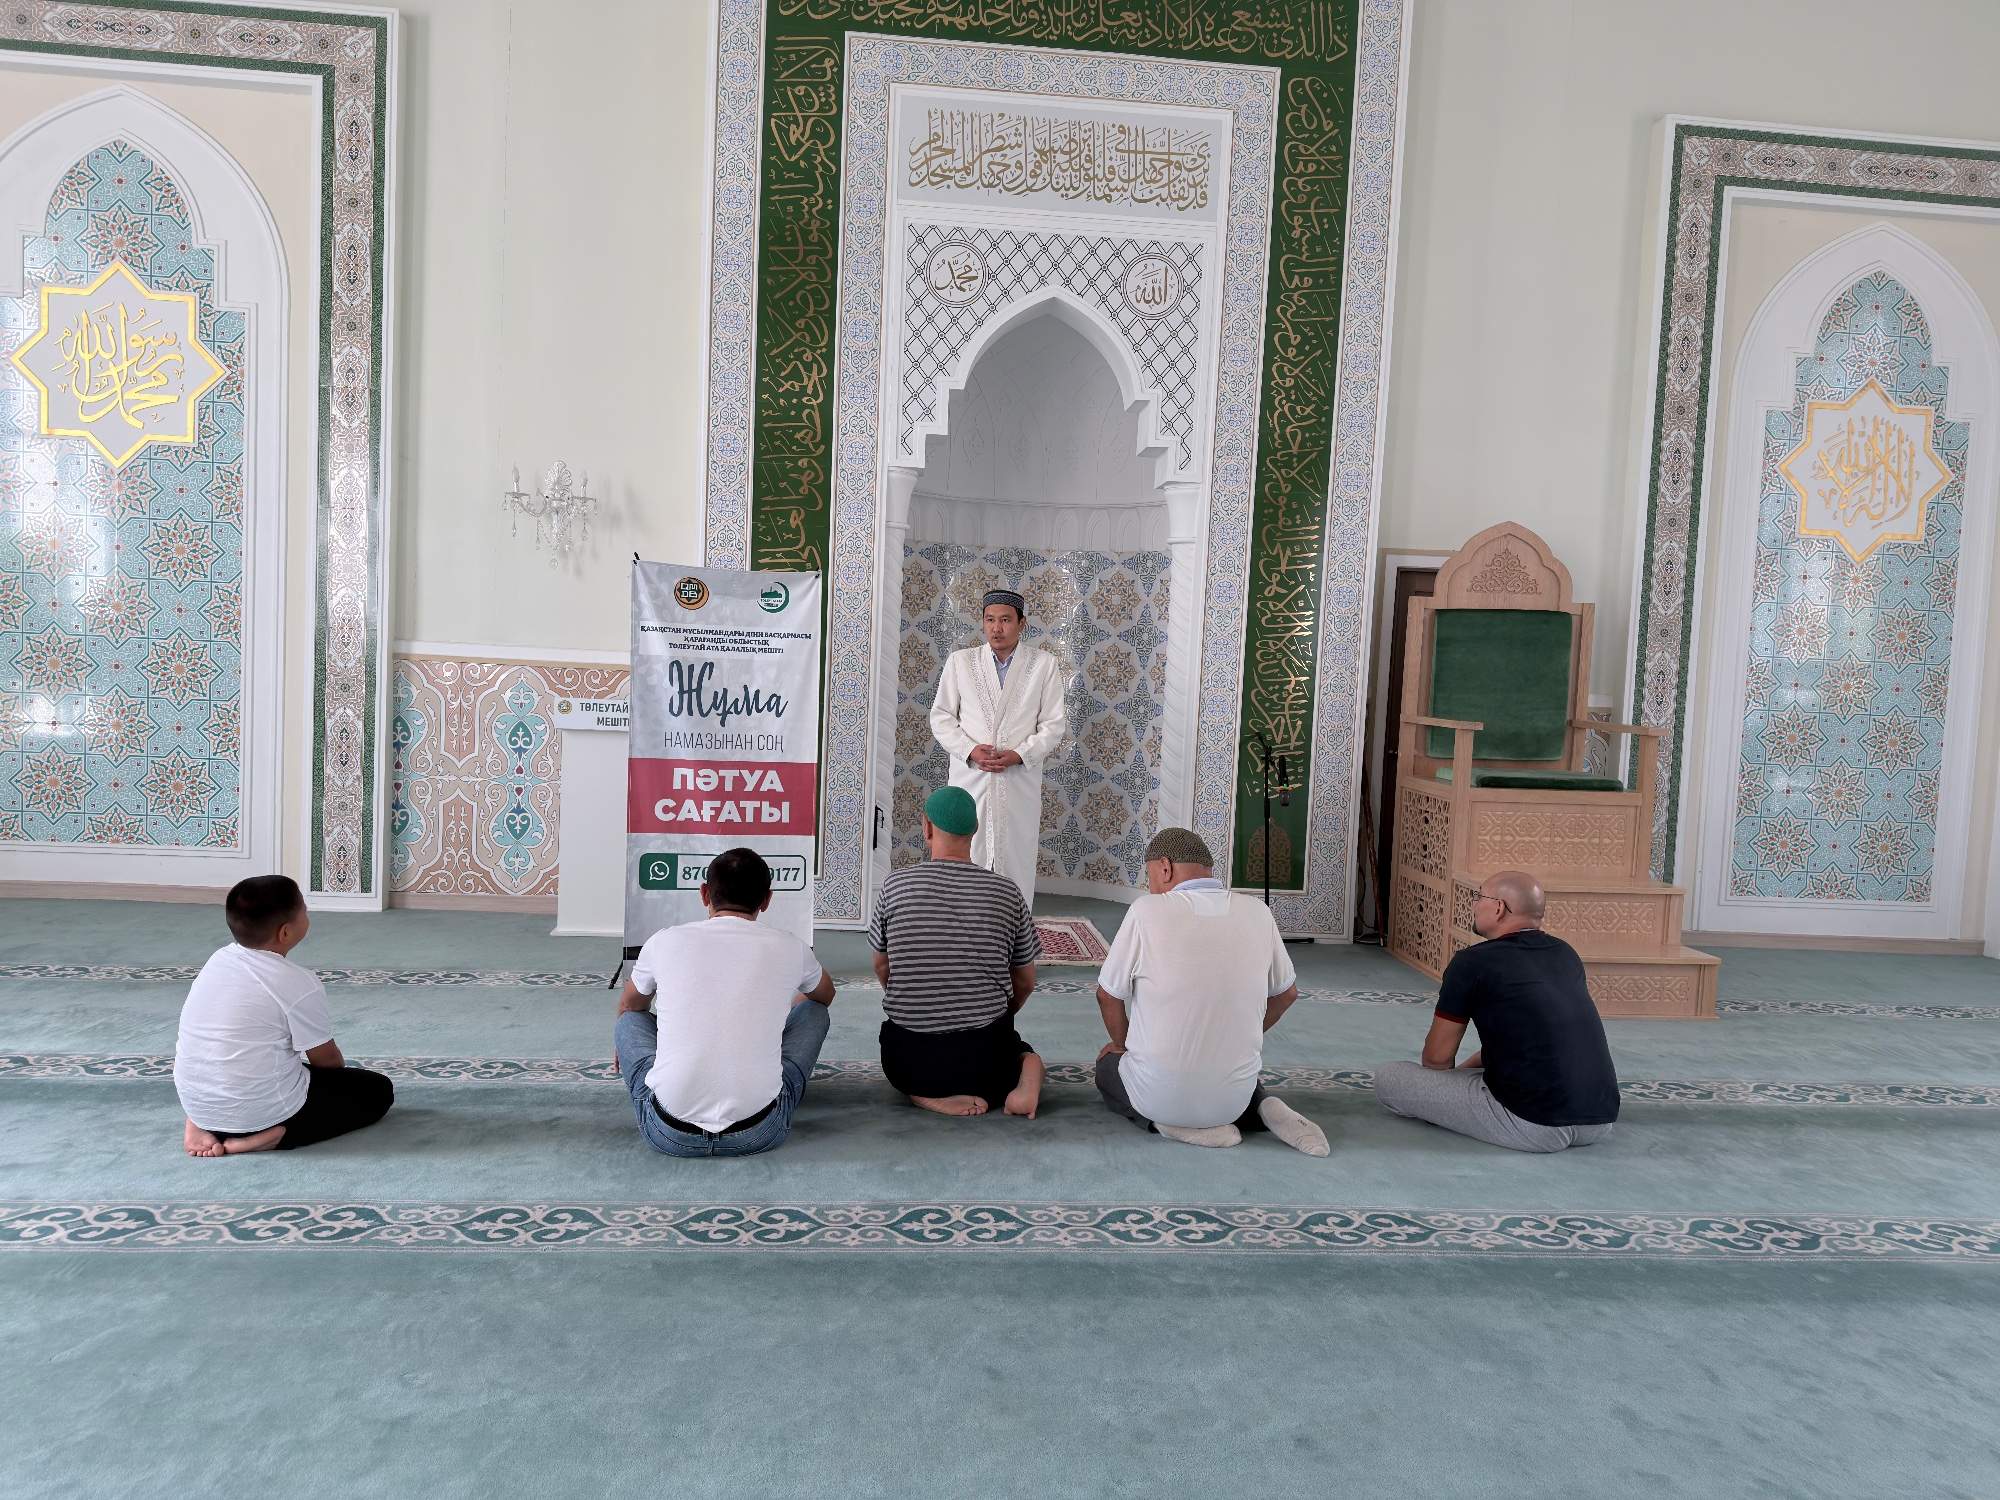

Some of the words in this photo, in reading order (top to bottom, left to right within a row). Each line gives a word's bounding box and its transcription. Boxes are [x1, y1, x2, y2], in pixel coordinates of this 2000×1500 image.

[580, 701, 629, 714] ТӨЛЕУТАЙ
[664, 731, 754, 751] НАМАЗЫНАН
[757, 734, 784, 752] СОҢ
[672, 767, 785, 793] ПӘТУА
[654, 798, 791, 824] САҒАТЫ
